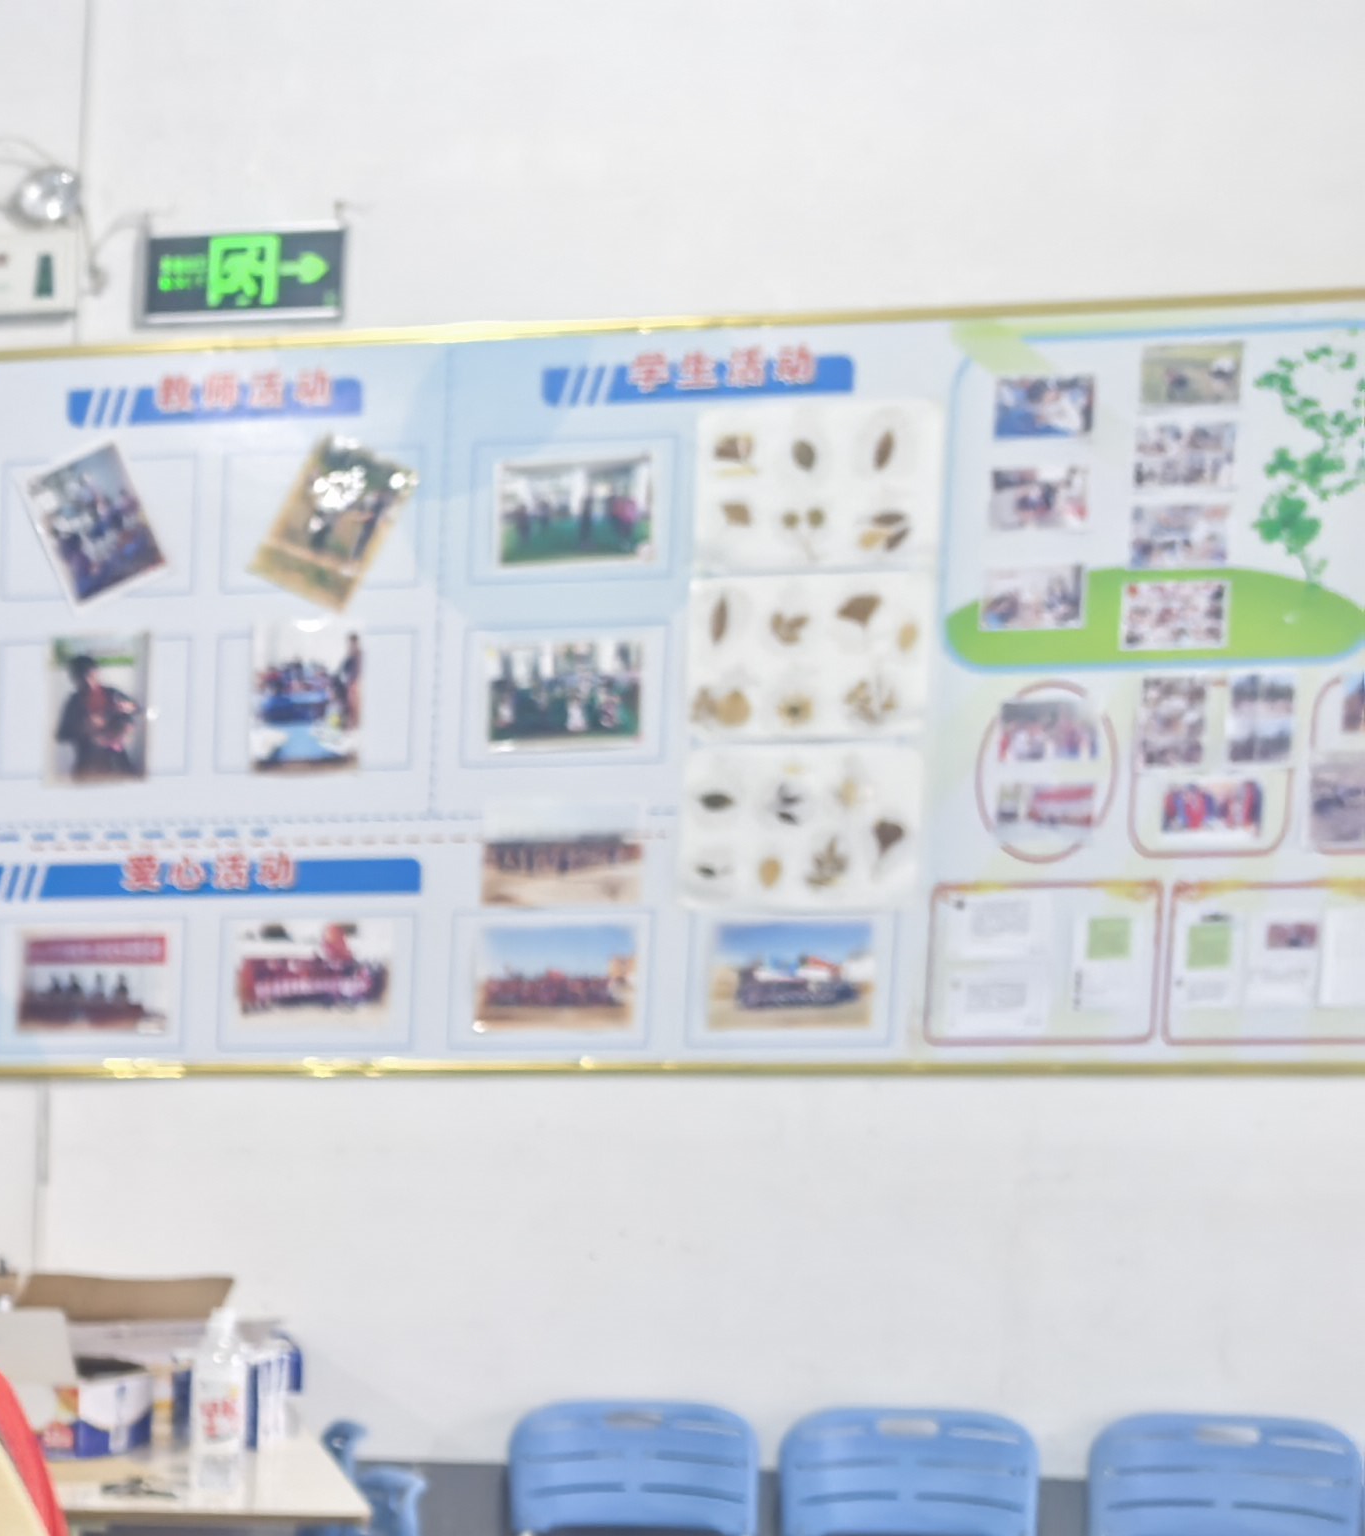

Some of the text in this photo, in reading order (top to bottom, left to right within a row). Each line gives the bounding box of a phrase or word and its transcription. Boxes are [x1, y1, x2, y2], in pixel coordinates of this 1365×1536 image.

[627, 344, 818, 392] 学生活动
[155, 369, 334, 414] 教师活动
[119, 851, 299, 893] 爱心活动
